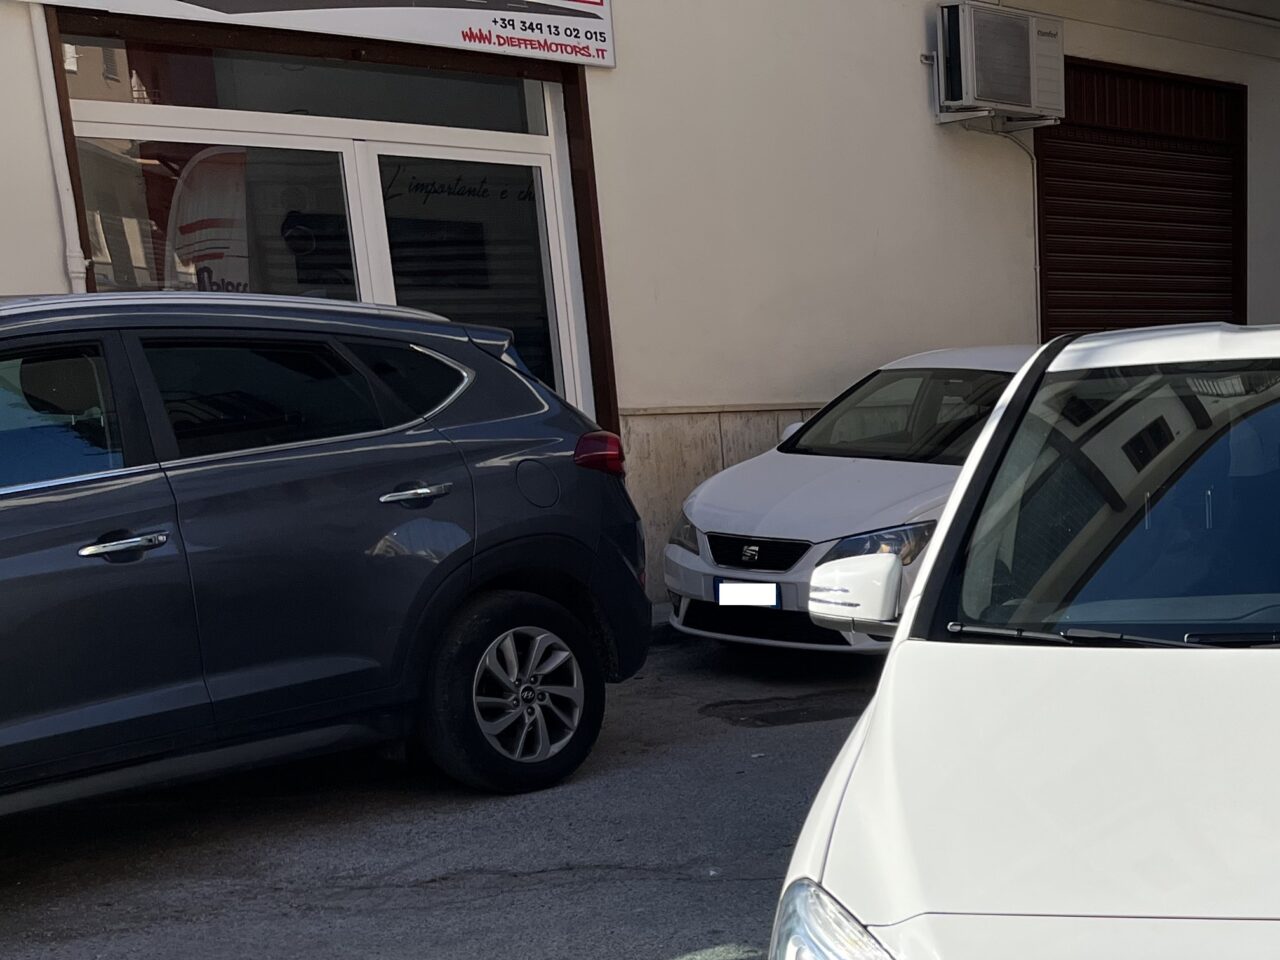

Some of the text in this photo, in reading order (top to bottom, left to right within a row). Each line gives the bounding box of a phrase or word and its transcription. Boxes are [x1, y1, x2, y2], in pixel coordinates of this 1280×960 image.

[461, 27, 608, 60] WWW.DIEFFEMOTORS.IT
[491, 17, 607, 43] +39 349 13 02 015
